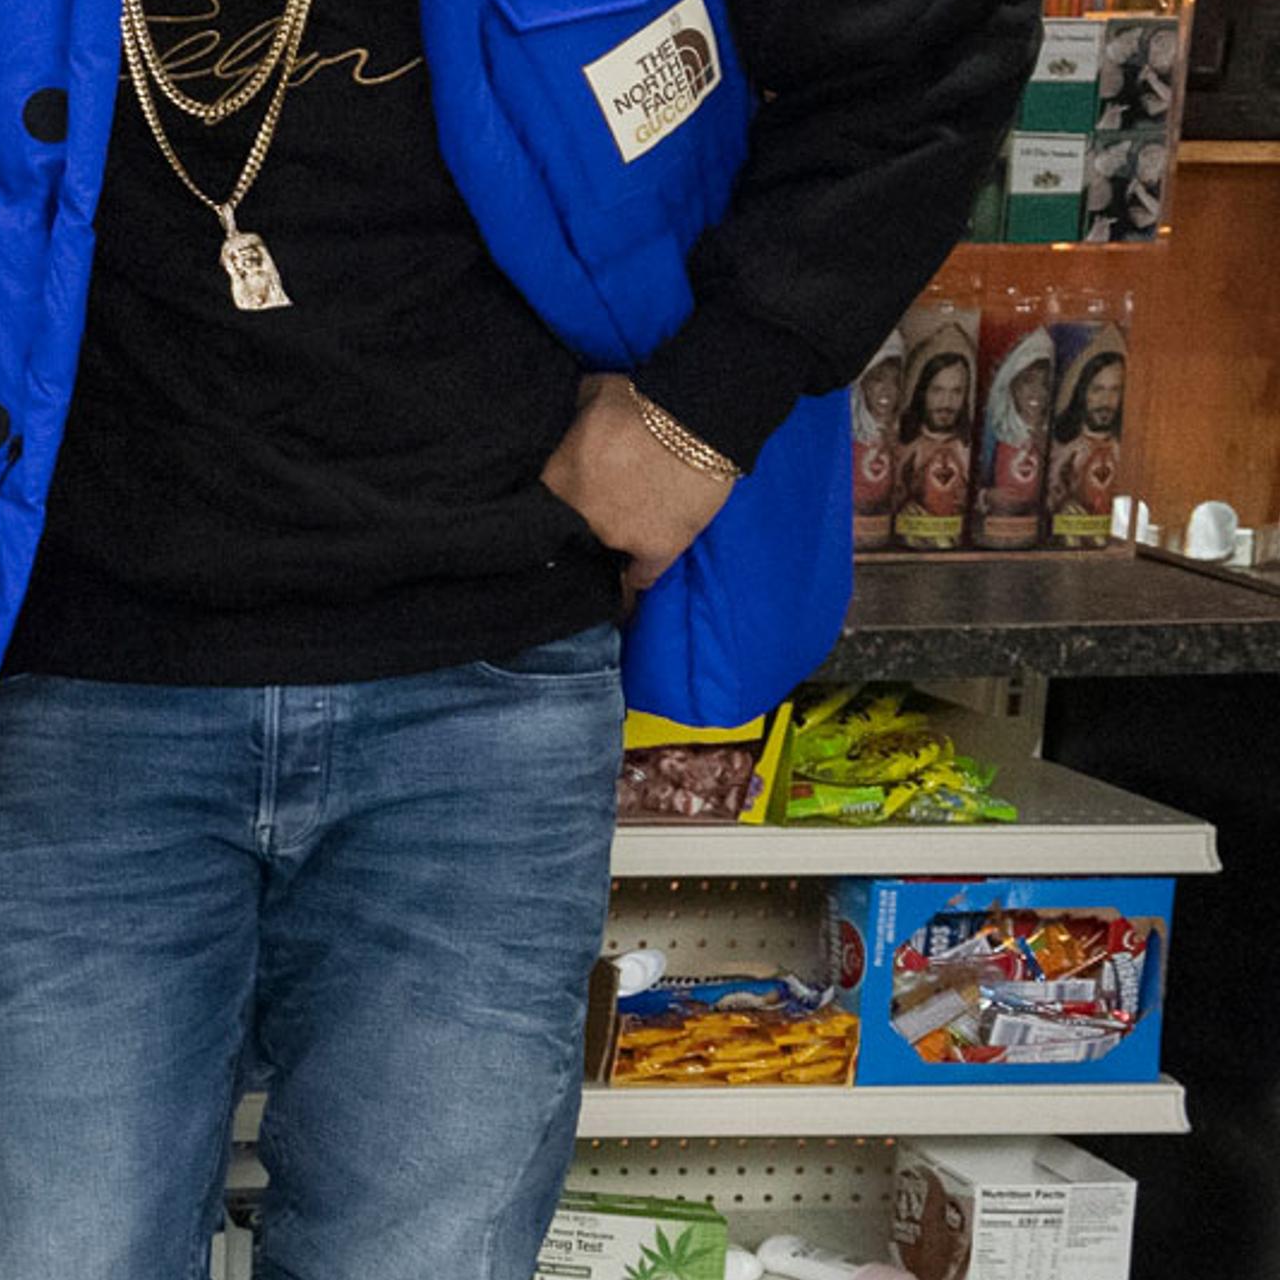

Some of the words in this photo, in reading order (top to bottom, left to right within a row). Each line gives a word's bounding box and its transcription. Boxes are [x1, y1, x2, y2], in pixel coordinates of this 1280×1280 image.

[637, 38, 676, 74] THE
[613, 56, 683, 115] NORTH
[642, 73, 688, 118] FACE
[635, 90, 697, 143] GUCCI
[1035, 1190, 1067, 1199] Facts
[577, 1239, 604, 1254] Test
